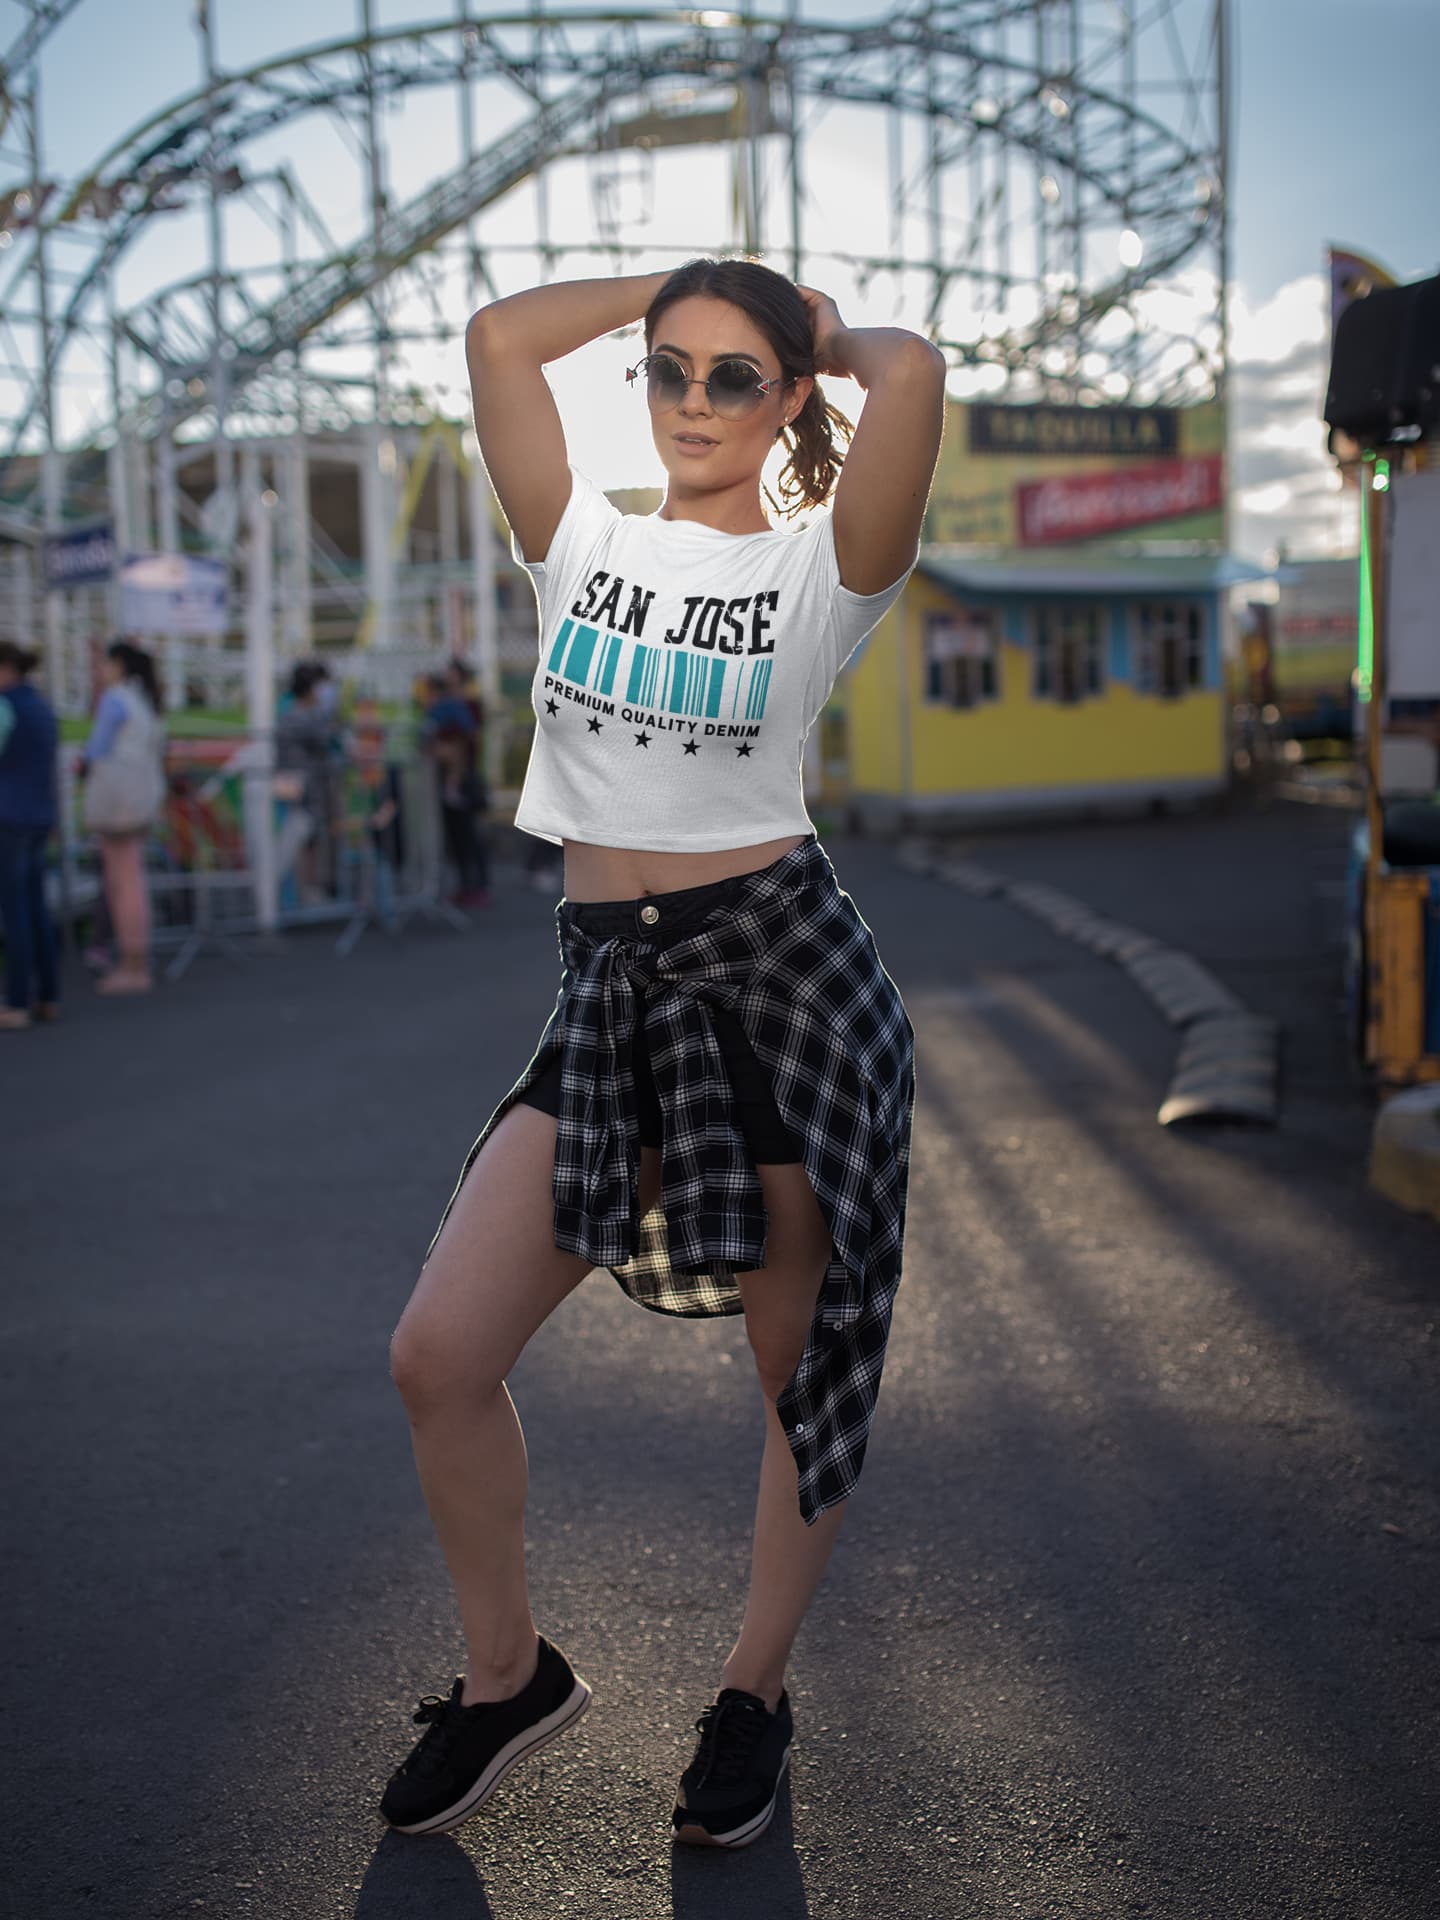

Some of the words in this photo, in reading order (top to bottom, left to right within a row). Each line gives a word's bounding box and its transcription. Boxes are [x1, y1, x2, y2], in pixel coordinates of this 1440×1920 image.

[571, 570, 656, 638] SAN
[663, 590, 779, 656] JOSE
[545, 676, 615, 716] PREMIUM
[620, 708, 698, 734] QUALITY
[704, 724, 760, 737] DENIM
